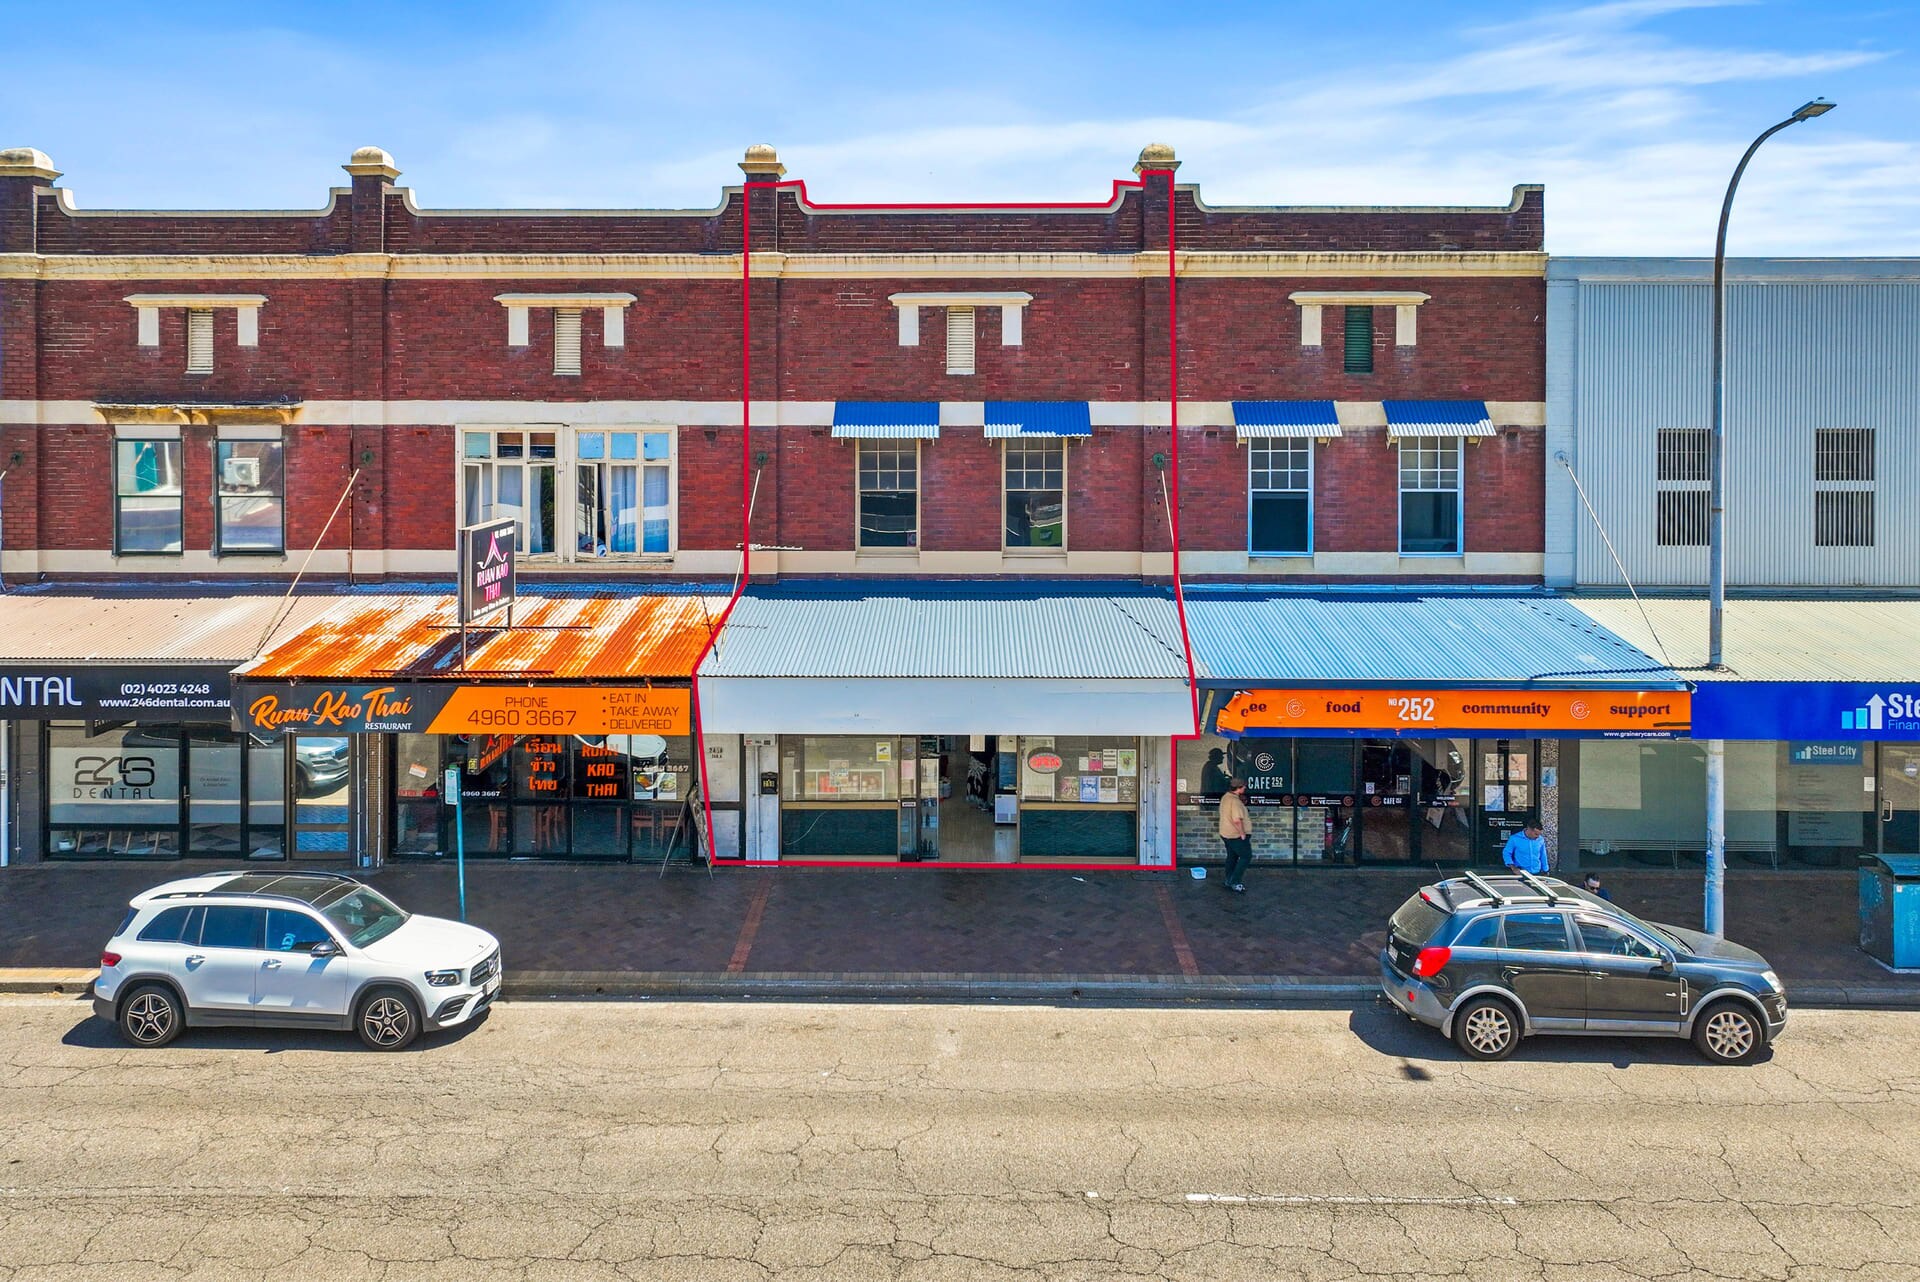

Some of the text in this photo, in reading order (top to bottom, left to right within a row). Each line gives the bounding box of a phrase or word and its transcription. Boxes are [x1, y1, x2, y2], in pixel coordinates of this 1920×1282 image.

[477, 562, 509, 587] RUAN KAO
[484, 581, 501, 602] THAI
[1, 677, 82, 706] NTAL
[121, 683, 210, 695] (02) 4023 4248
[100, 698, 230, 707] www.246dental.com.au
[505, 697, 548, 707] PHONE
[610, 693, 646, 703] EAT IN
[249, 687, 413, 730] Ruan Kao Thai
[610, 706, 679, 717] TAKE AWAY
[1326, 701, 1361, 713] food
[1398, 697, 1434, 721] 252
[1462, 702, 1551, 717] community
[1610, 704, 1671, 718] support
[467, 710, 577, 726] 4960 3667
[610, 719, 672, 730] DELIVERED
[365, 722, 412, 730] RESTAURANT
[1888, 720, 1920, 730] Finan
[525, 738, 563, 754] เรือน
[582, 744, 619, 757] RUAN
[1812, 745, 1857, 760] Steel City
[530, 756, 556, 772] ข้าว
[1030, 756, 1061, 768] OPEN
[74, 756, 155, 787] 246
[587, 763, 615, 776] KAO
[528, 775, 558, 791] ไทย
[1247, 776, 1283, 789] CAFE 252
[73, 788, 155, 799] DENTAL
[587, 783, 618, 796] THAI
[1383, 797, 1395, 805] CAFE
